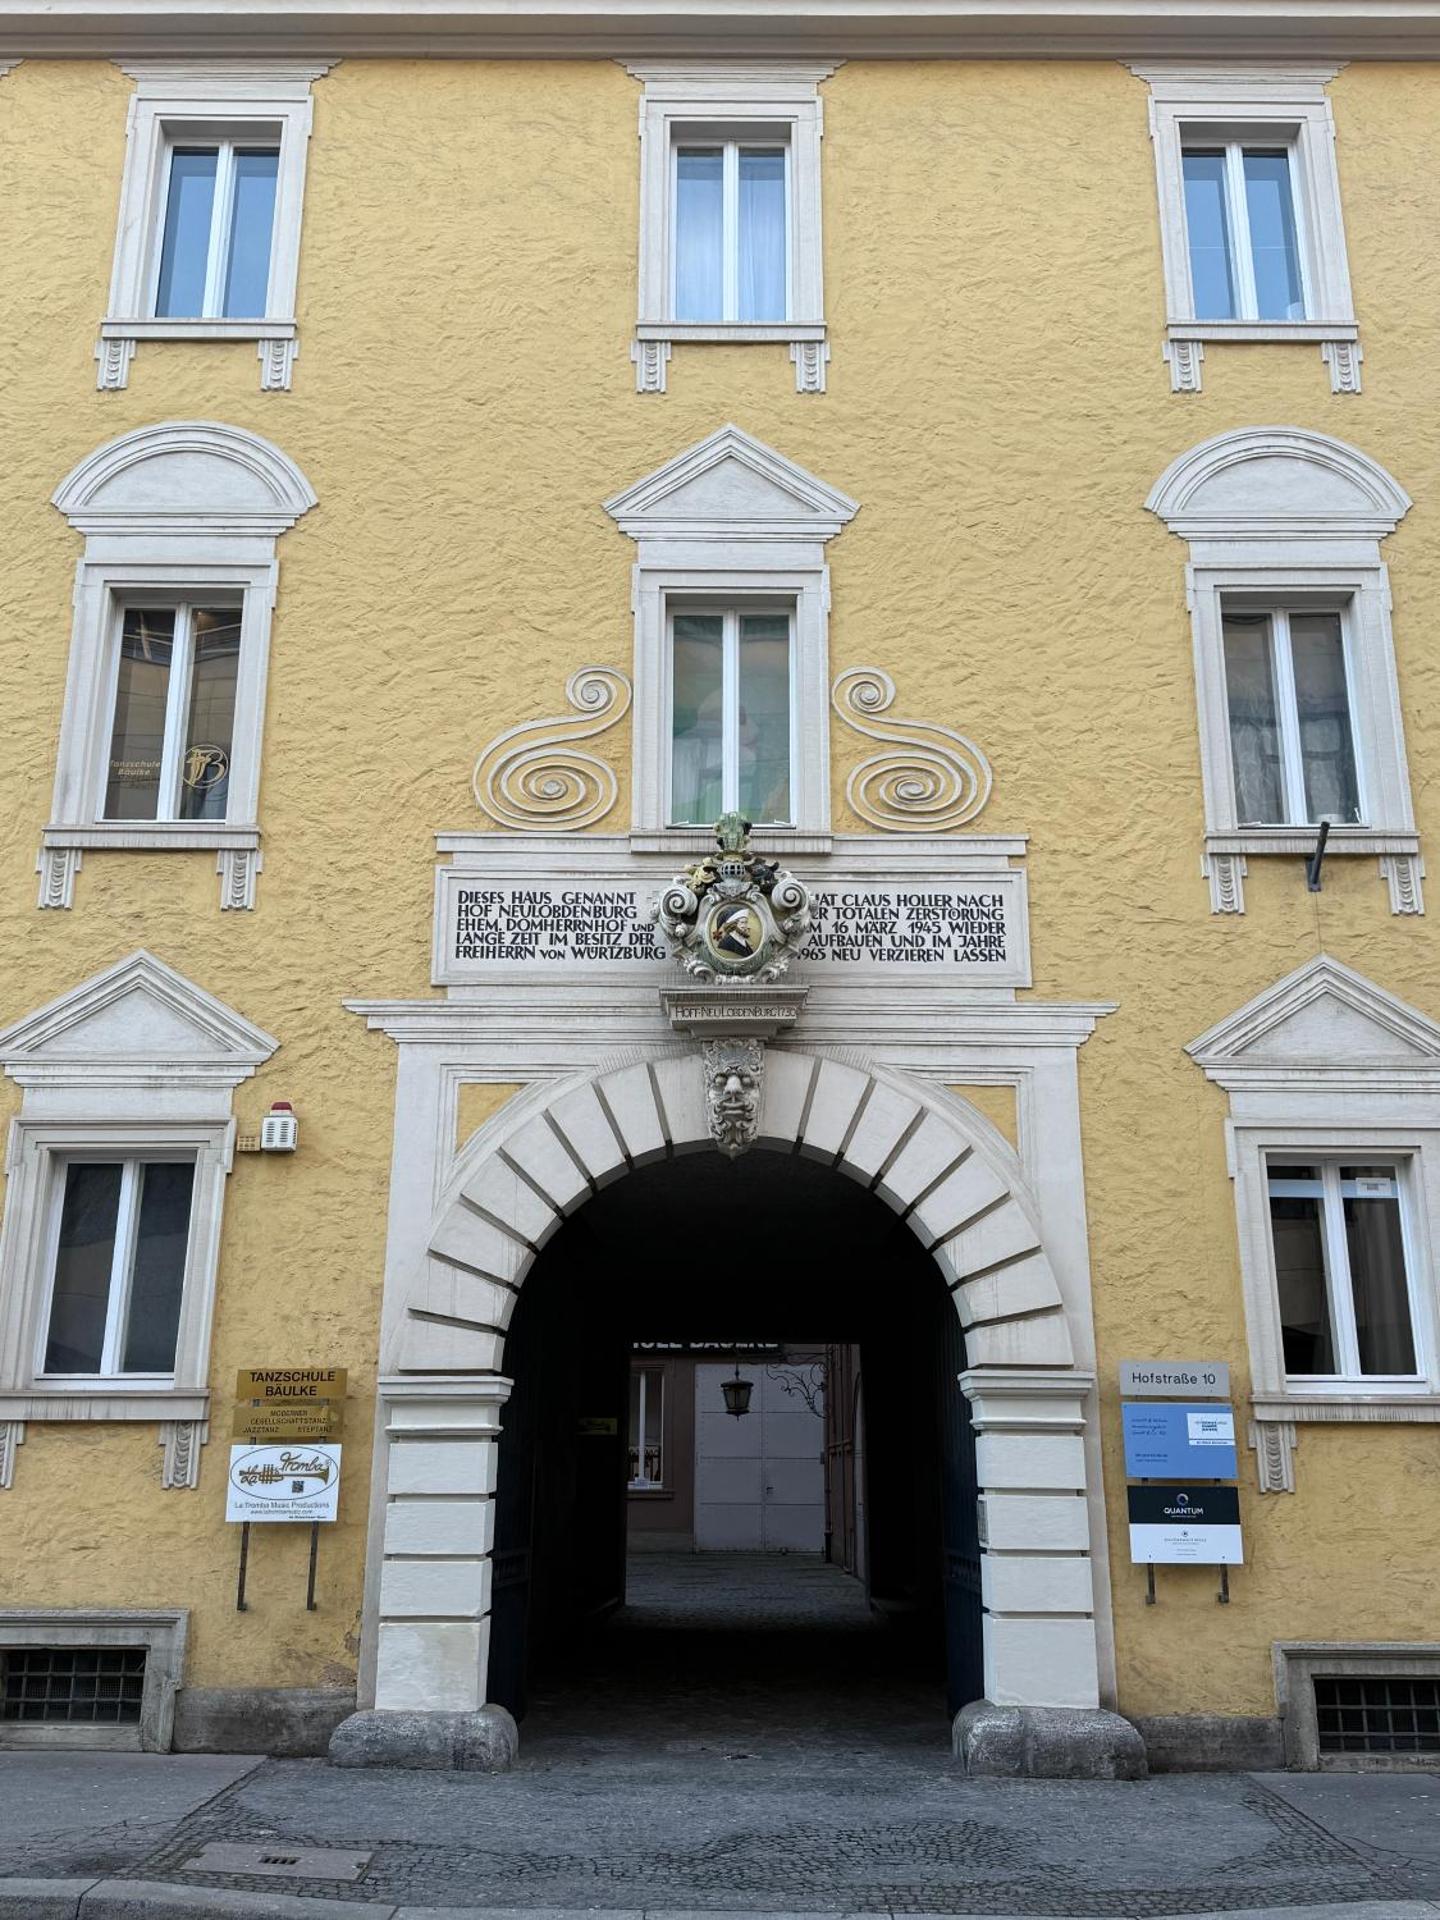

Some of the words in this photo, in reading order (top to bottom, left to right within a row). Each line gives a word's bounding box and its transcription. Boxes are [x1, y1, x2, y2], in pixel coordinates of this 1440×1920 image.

[457, 890, 505, 904] DIESES
[511, 891, 552, 904] HAUS
[561, 891, 637, 905] GENANNT
[842, 894, 891, 907] CLAUS
[896, 894, 953, 908] HOLLER
[957, 894, 1004, 907] NACH
[457, 904, 493, 917] HOF
[499, 905, 637, 919] NEULOBDENBURG
[832, 907, 899, 920] TOTALEN
[456, 918, 502, 932] EHEM.
[506, 918, 628, 932] DOMHERRNHOF
[632, 923, 655, 932] UND
[832, 921, 849, 934] 16
[856, 920, 898, 935] MÄRZ
[908, 921, 942, 934] 1945
[948, 921, 1007, 936] WIEDER
[456, 932, 505, 945] LANGE
[510, 932, 542, 945] ZEIT
[549, 933, 568, 946] IM
[575, 933, 623, 946] BESITZ
[629, 933, 656, 946] DER
[808, 934, 883, 947] AUFBAUEN
[891, 935, 925, 947] UND
[933, 935, 952, 947] IM
[957, 935, 1005, 948] JAHRE
[455, 945, 536, 960] FREIHERRN
[539, 949, 566, 960] VON
[797, 948, 827, 960] 965
[832, 948, 861, 961] NEU
[869, 949, 945, 962] VERZIEREN
[953, 949, 1007, 962] LASSEN
[250, 1371, 336, 1382] TANZSCHULE
[1132, 1372, 1198, 1384] Hofstraße
[1202, 1373, 1216, 1384] 10
[265, 1383, 317, 1396] BÄULKE
[279, 1451, 322, 1472] Tromba
[1163, 1507, 1204, 1515] QUANTUM
